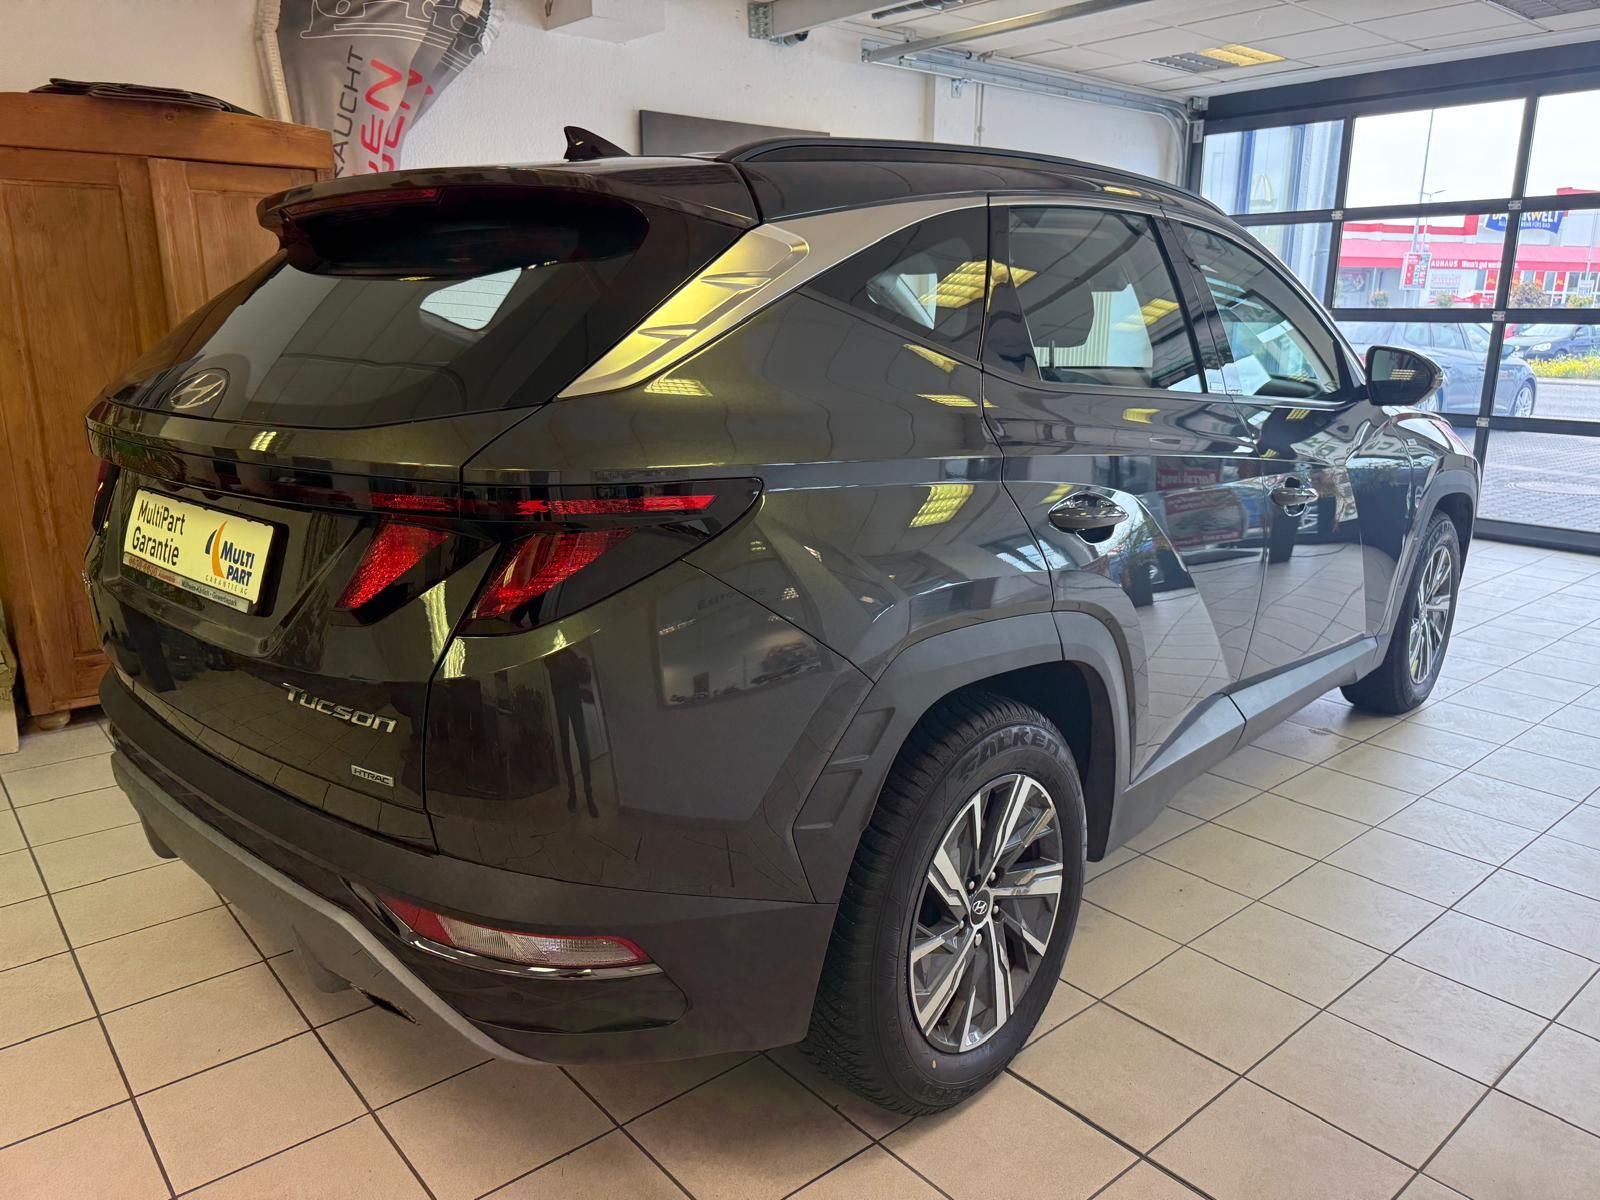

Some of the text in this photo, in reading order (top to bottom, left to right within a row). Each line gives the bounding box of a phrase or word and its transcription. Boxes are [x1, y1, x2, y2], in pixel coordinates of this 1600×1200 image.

[138, 499, 185, 536] MultiPart
[132, 526, 180, 567] Garantie
[220, 540, 255, 570] MULTI
[205, 574, 238, 592] GARANTIE
[226, 564, 252, 587] PART
[958, 726, 1066, 783] FALKEN
[354, 767, 391, 785] HTRAC
